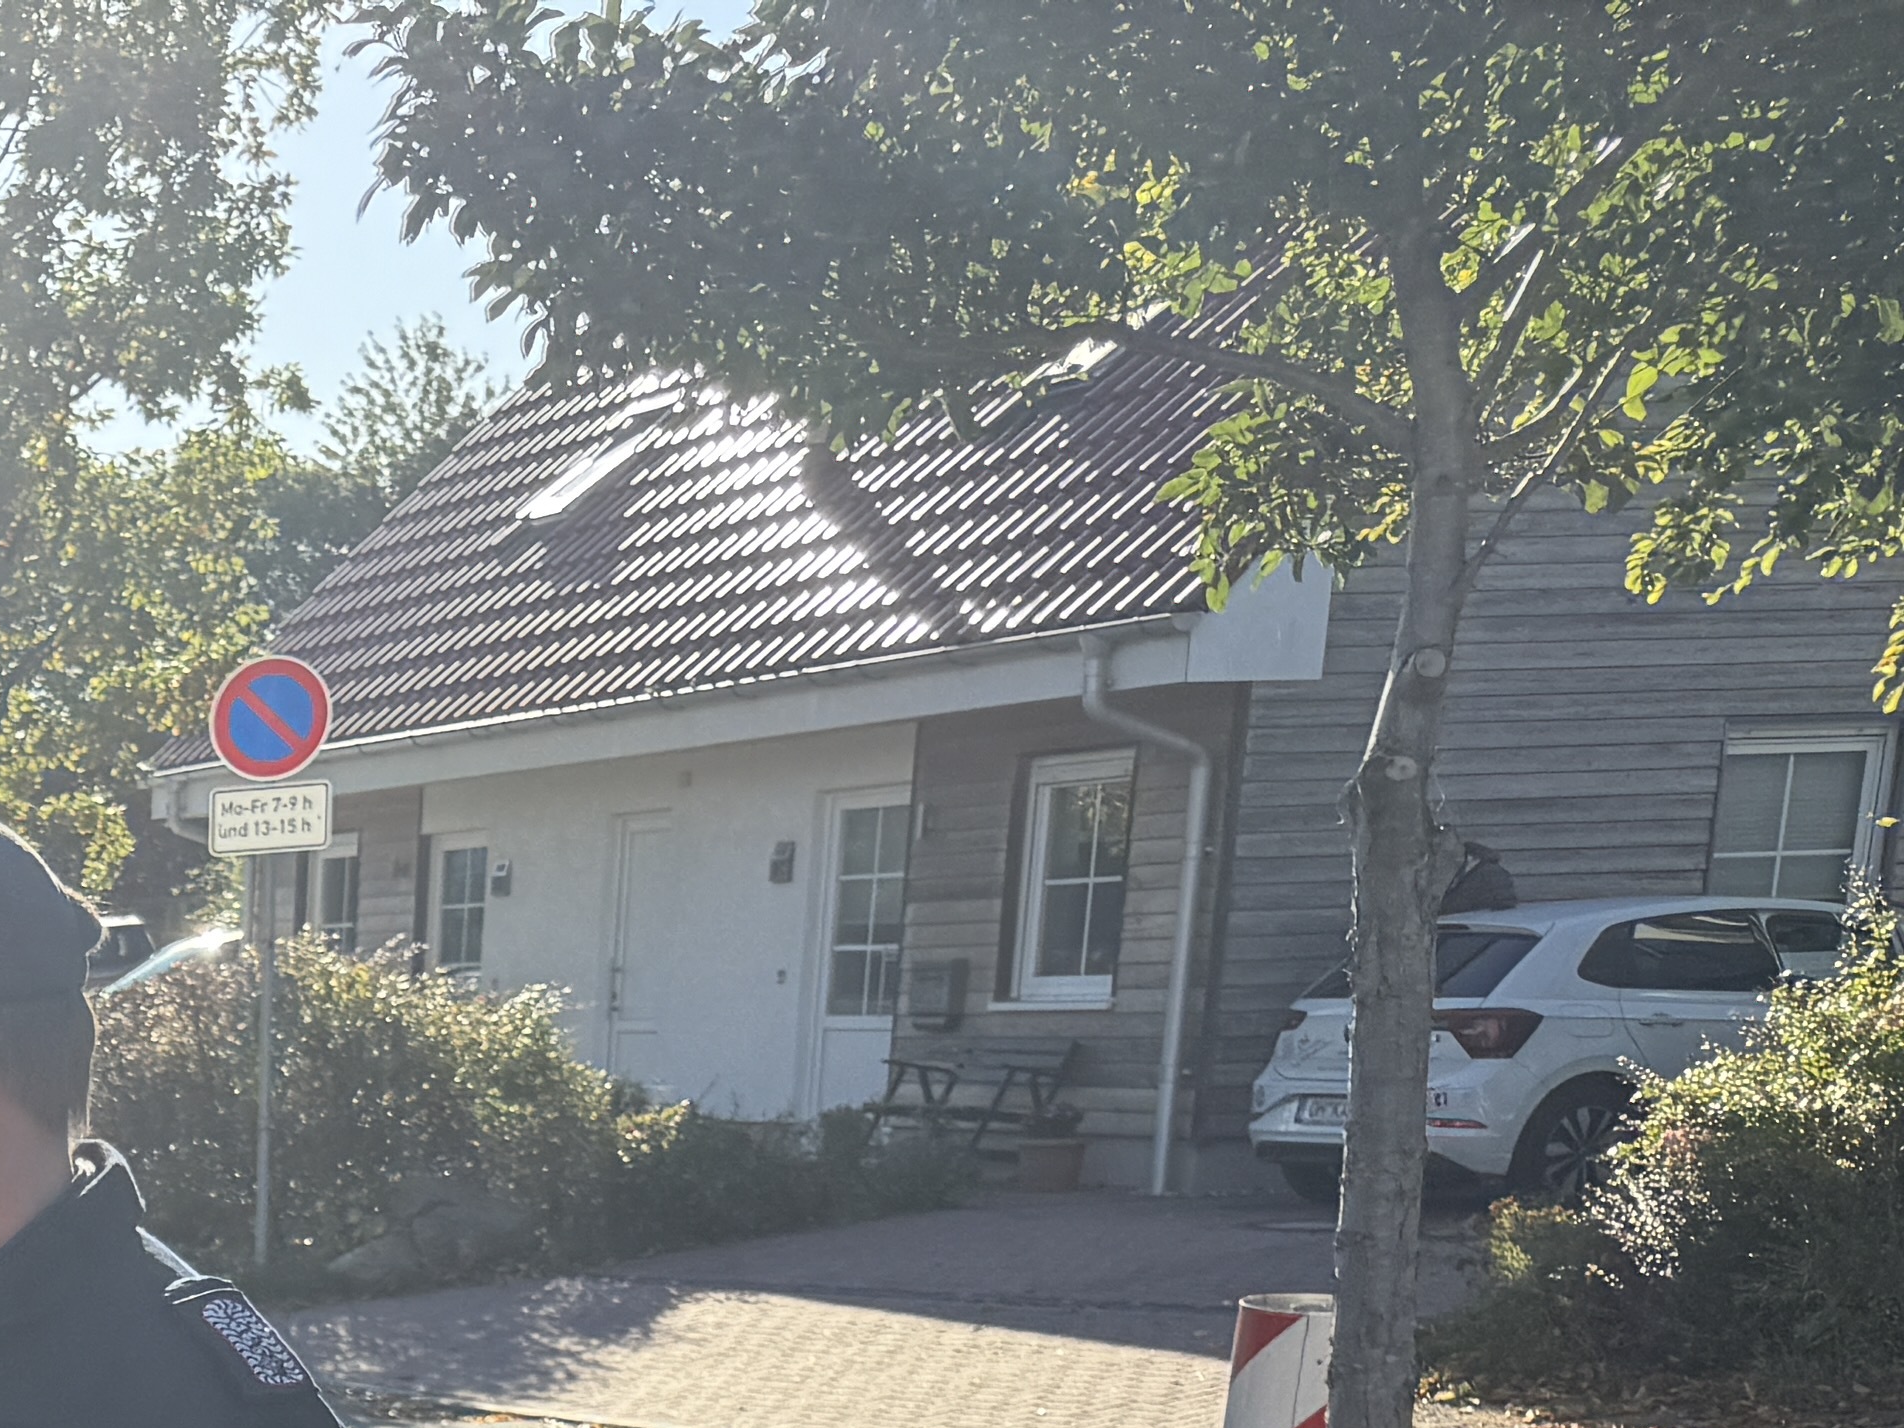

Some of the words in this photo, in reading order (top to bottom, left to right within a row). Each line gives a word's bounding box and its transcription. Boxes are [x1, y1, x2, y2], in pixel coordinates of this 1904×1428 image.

[220, 798, 269, 817] Mo-Fr
[271, 796, 299, 813] 7-9
[302, 795, 313, 811] h
[218, 821, 249, 839] und
[253, 817, 298, 837] 13-15
[301, 817, 312, 833] h
